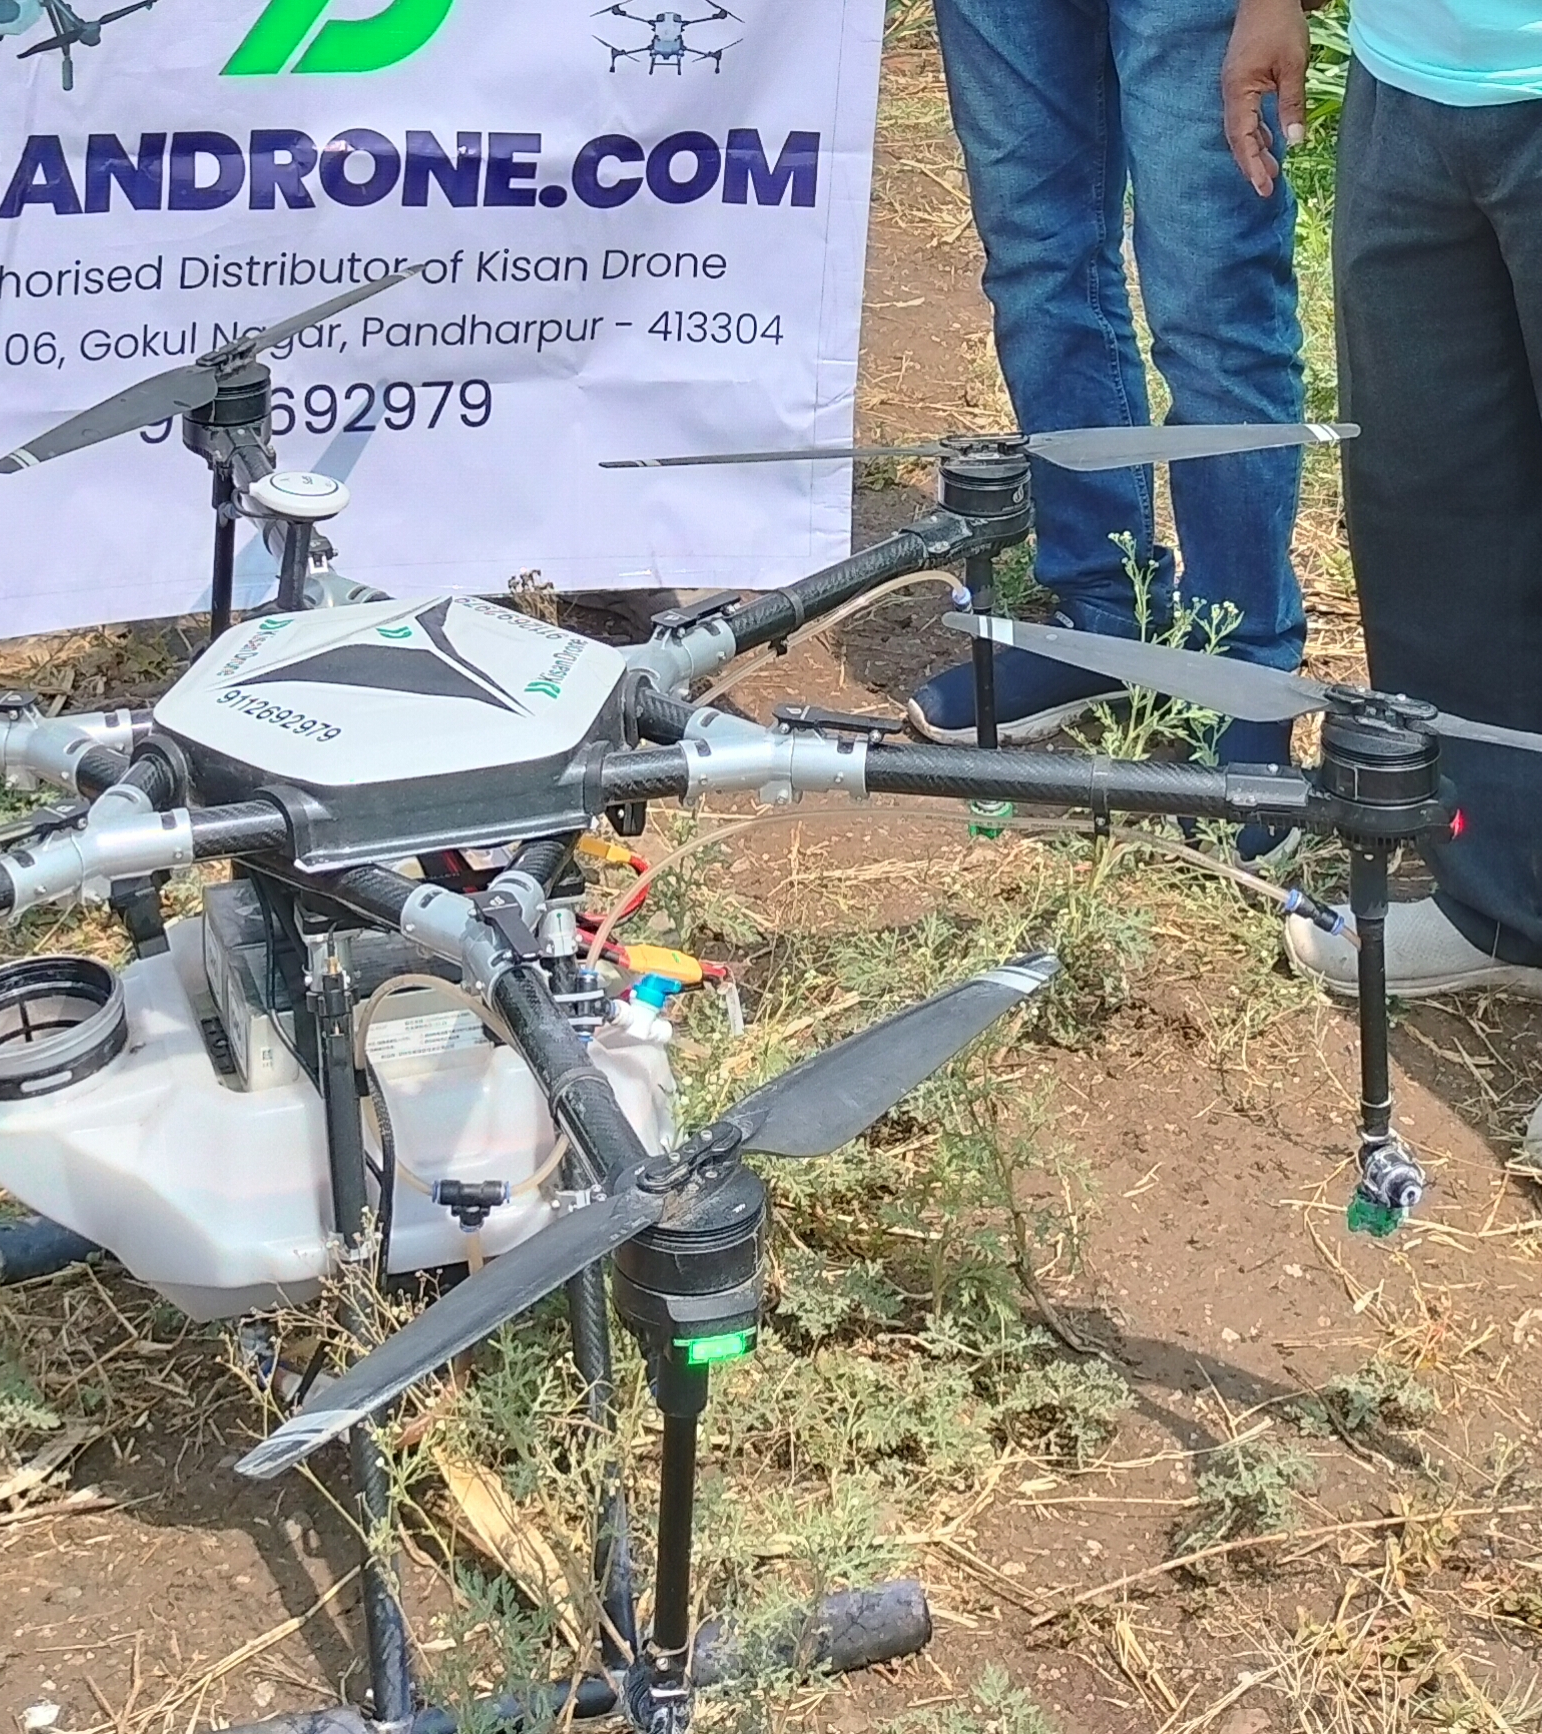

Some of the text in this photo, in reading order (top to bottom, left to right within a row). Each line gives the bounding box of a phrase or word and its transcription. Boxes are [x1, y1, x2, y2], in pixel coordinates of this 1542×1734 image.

[179, 252, 408, 290] Distributor
[421, 249, 464, 284] of
[476, 248, 588, 283] Kisan
[601, 249, 727, 280] Drone
[4, 331, 65, 370] 06,
[79, 321, 197, 362] Gokul
[361, 314, 604, 353] Pandharpur
[647, 310, 784, 346] 413304
[140, 378, 492, 444] 692979
[216, 688, 343, 743] 9112692979
